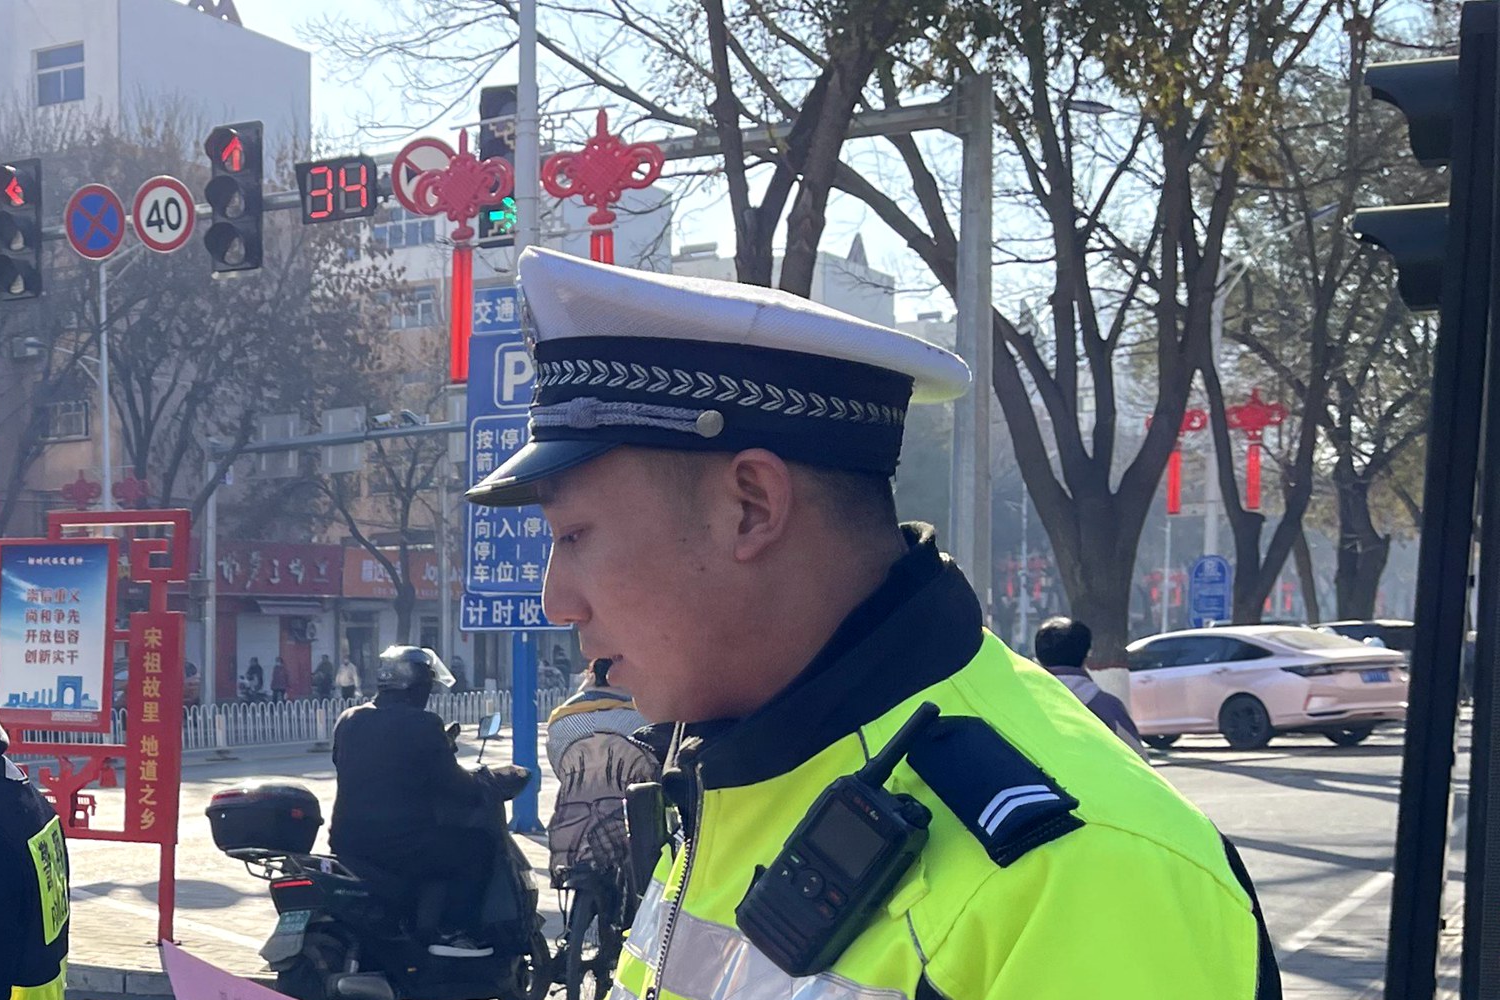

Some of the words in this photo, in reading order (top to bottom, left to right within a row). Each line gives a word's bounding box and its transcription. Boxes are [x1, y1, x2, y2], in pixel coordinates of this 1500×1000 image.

[146, 197, 181, 232] 40
[310, 165, 367, 218] 34
[503, 351, 535, 401] P
[474, 429, 493, 583] 按箭方向停车
[25, 629, 80, 645] 开放包容
[26, 608, 80, 625] 尚和争先
[25, 649, 79, 665] 创新实干
[141, 627, 163, 723] 宋祖故里
[138, 735, 160, 830] 地道之乡
